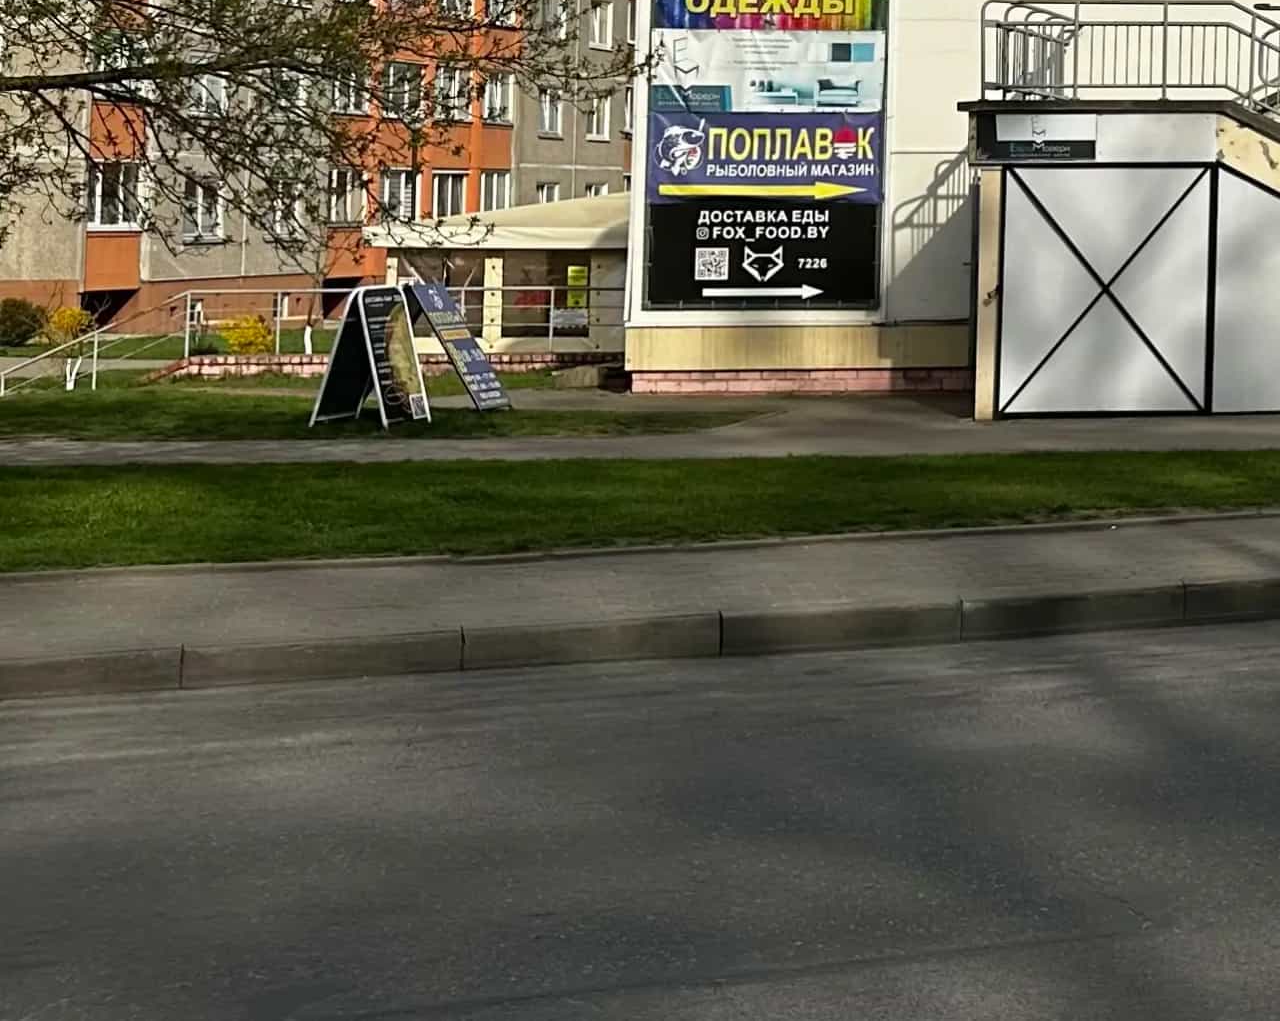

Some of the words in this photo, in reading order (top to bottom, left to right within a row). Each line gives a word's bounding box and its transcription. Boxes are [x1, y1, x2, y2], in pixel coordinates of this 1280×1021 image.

[706, 163, 807, 178] РЫБОЛОВНЫЙ
[810, 163, 875, 177] МАГАЗИН
[698, 210, 788, 225] ДОСТАВКА
[791, 210, 829, 224] ЕДЫ
[712, 226, 830, 242] FOX_FOOD.BY
